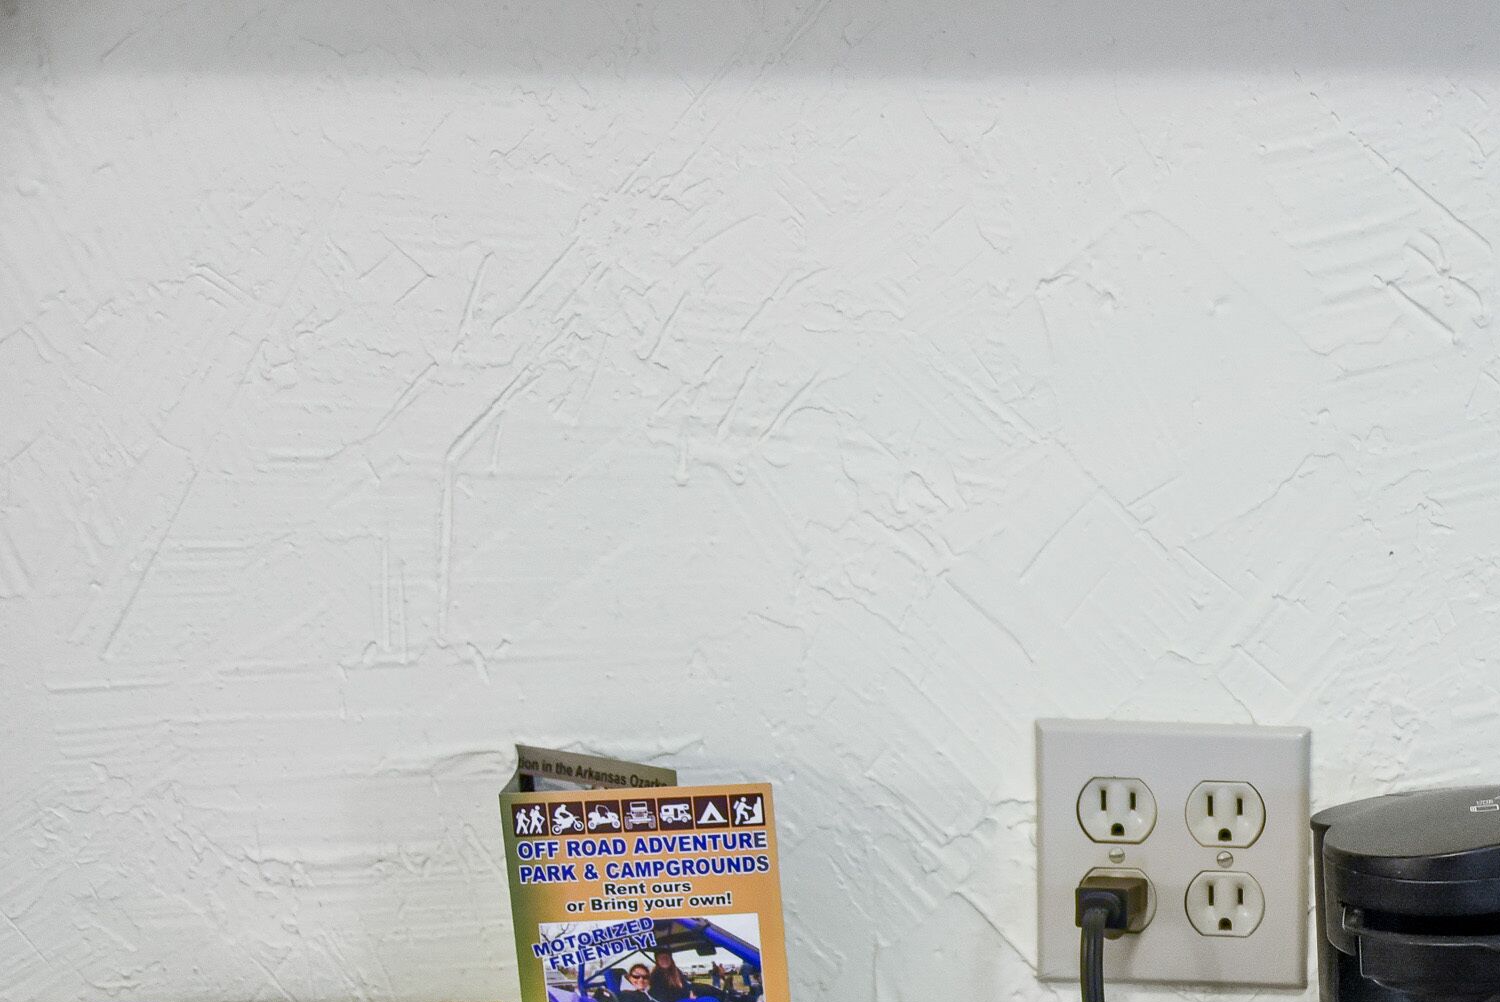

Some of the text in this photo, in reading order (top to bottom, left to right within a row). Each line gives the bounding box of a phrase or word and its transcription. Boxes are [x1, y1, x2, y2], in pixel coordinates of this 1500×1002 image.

[542, 763, 552, 772] in
[555, 762, 574, 776] the
[575, 766, 626, 786] Arkansas
[516, 831, 768, 860] OFF ROAD ADVENTURE
[519, 855, 770, 884] PARK & CAMPGROUNDS
[566, 892, 733, 914] or Bring your own!
[604, 882, 692, 896] Rent ours
[532, 917, 655, 958] MOTORIZED
[549, 935, 658, 971] FRIENDLY!
